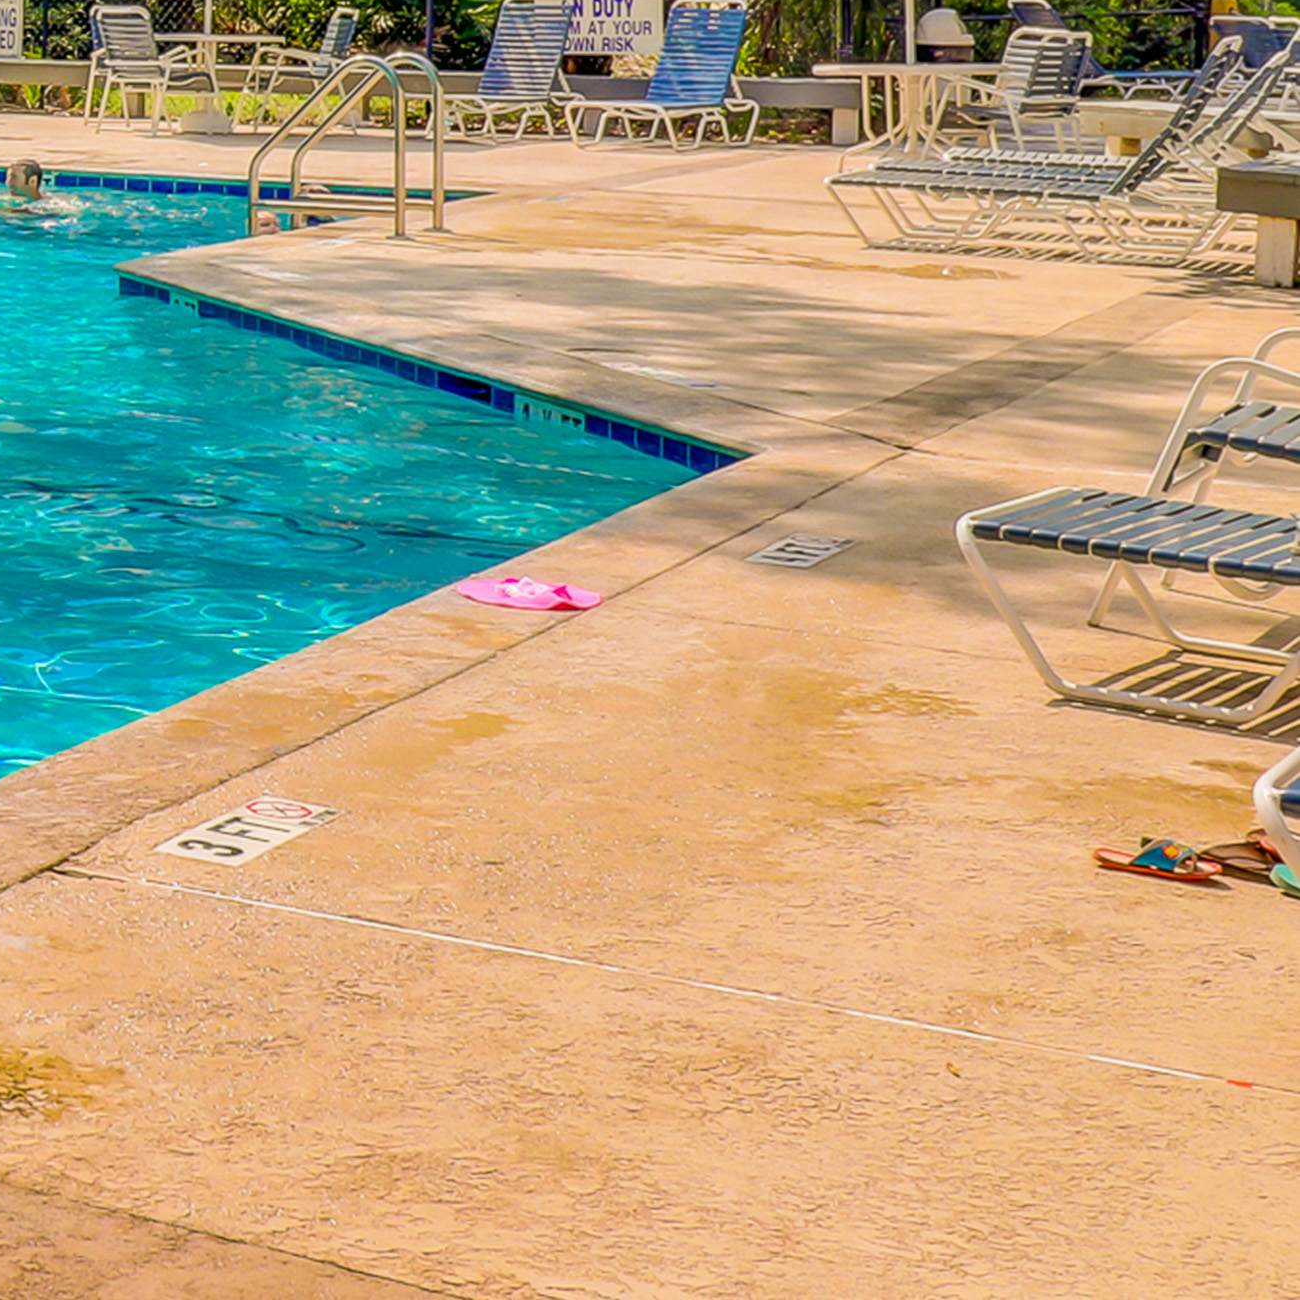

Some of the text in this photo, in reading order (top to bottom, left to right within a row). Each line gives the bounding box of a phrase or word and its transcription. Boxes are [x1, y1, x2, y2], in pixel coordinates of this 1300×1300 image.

[588, 21, 605, 35] AT
[613, 21, 652, 35] YOUR
[563, 37, 634, 52] OWN RISK
[206, 816, 292, 843] FT
[177, 838, 245, 858] 3
